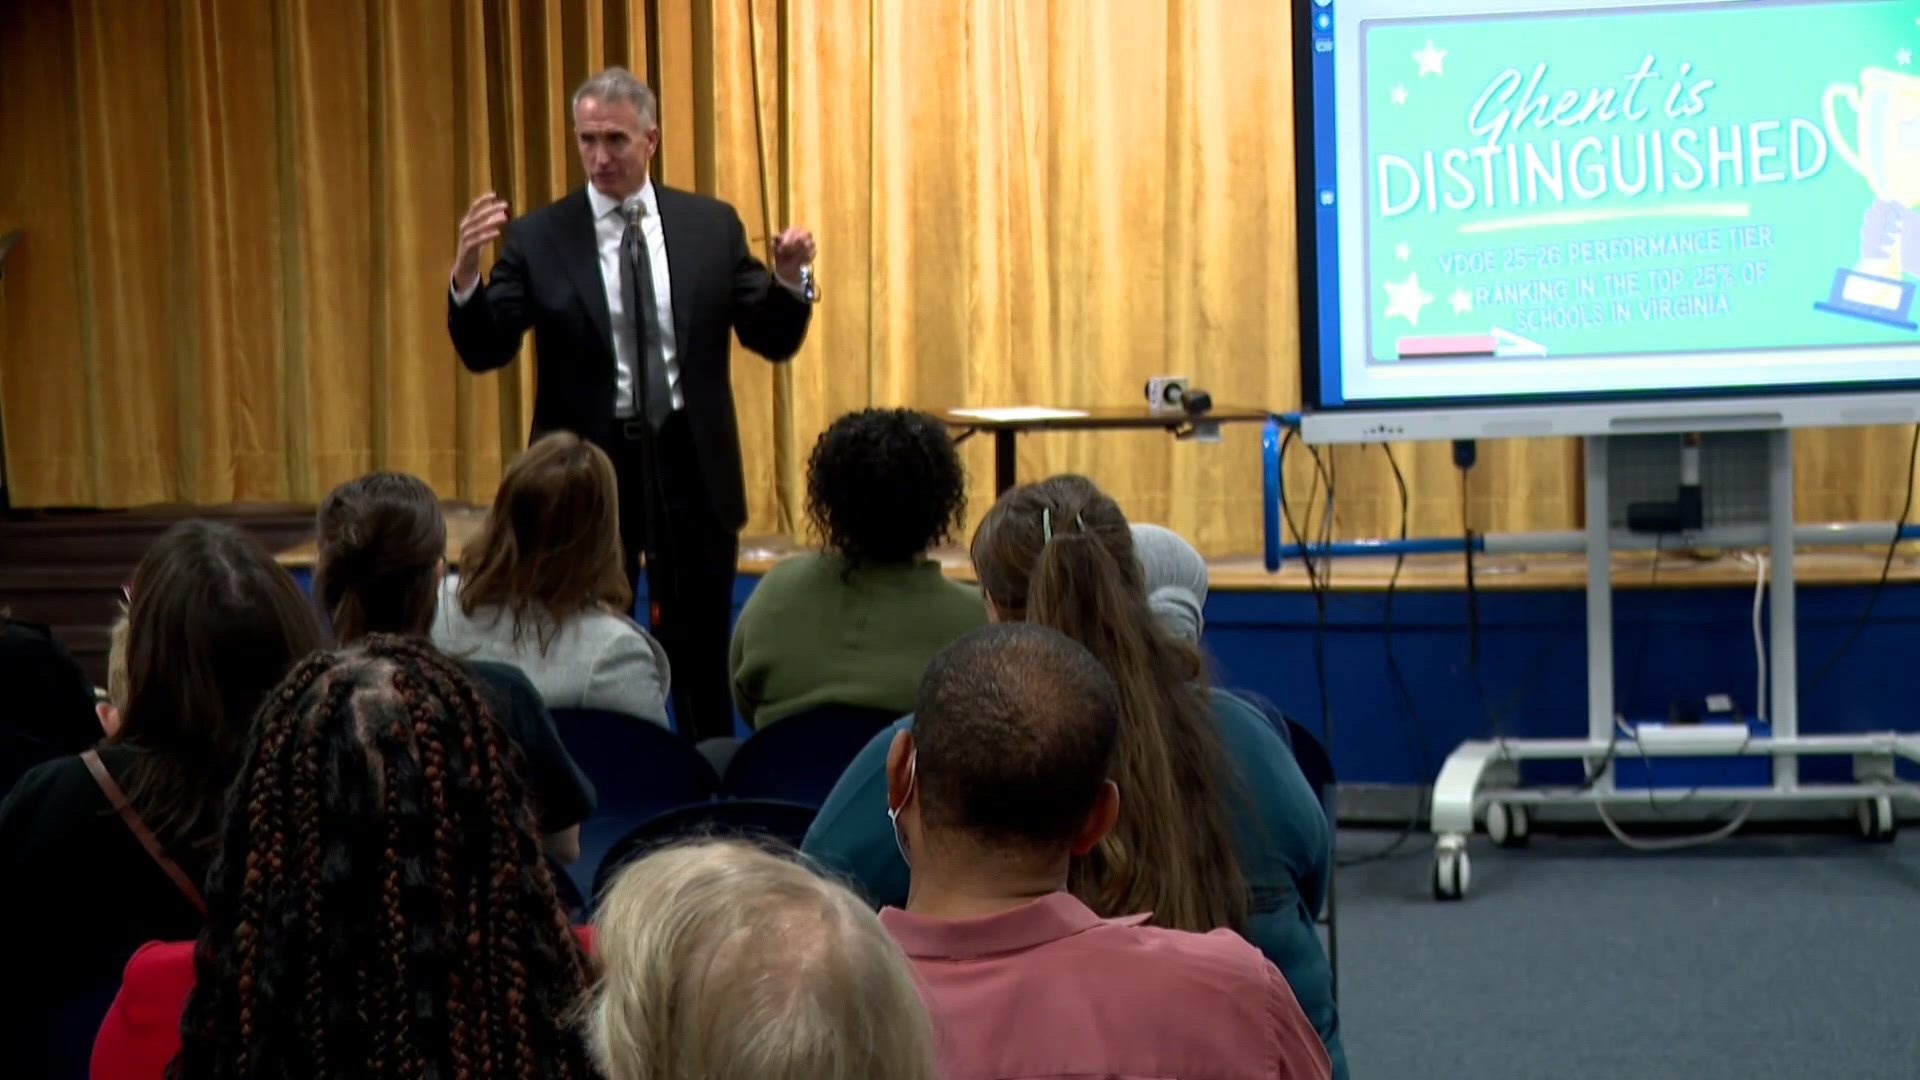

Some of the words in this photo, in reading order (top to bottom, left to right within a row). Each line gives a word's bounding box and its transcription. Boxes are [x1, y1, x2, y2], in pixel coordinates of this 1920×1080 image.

[1468, 54, 1660, 148] Ghent
[1664, 61, 1716, 118] is
[1378, 117, 1828, 216] DISTINGUISHED
[1440, 249, 1496, 273] VDOE
[1503, 246, 1562, 271] 25-26
[1567, 229, 1722, 264] PERFORMANCE
[1729, 224, 1775, 249] TIER
[1475, 279, 1568, 307] RANKING
[1576, 274, 1596, 298] IN
[1603, 271, 1640, 296] THE
[1649, 267, 1685, 291] TOP
[1693, 263, 1736, 288] 25%
[1742, 260, 1768, 284] OF
[1516, 303, 1604, 330] SCHOOLS
[1611, 300, 1632, 324] IN
[1639, 292, 1730, 320] VIRGINIA
